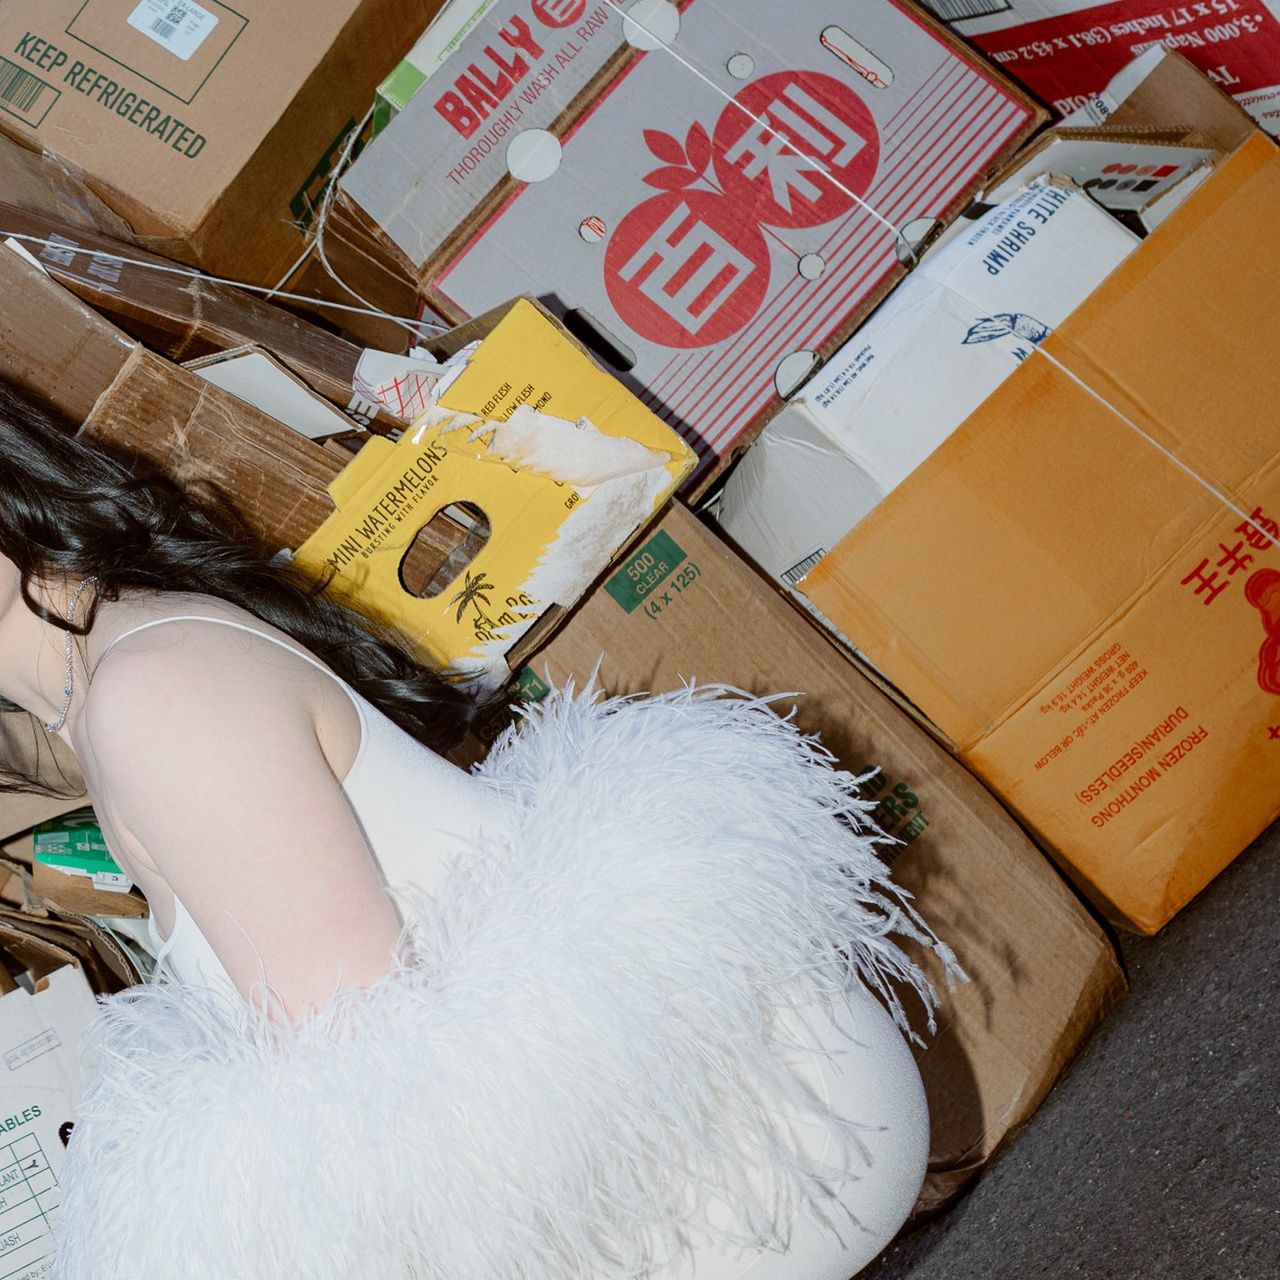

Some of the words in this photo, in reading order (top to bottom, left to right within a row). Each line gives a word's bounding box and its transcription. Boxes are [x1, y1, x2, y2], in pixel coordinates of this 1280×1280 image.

[1069, 27, 1111, 47] (38.1
[1111, 15, 1169, 34] Inches
[431, 14, 551, 138] BALLY
[15, 32, 67, 71] KEEP
[65, 62, 205, 158] REFRIGERATED
[447, 102, 523, 184] THOROUGHLY
[519, 64, 559, 104] WASH
[555, 42, 582, 69] ALL
[577, 6, 608, 41] RAW
[612, 74, 872, 342] 百利
[983, 222, 1035, 275] SHRIMP
[481, 401, 495, 416] RED
[493, 383, 512, 403] FLESH
[516, 384, 534, 407] FLESH
[326, 536, 362, 572] MINI
[356, 442, 446, 539] WATERMELONS
[361, 523, 395, 558] BURSTING
[395, 503, 413, 522] WITH
[412, 472, 438, 503] FLAVOR
[627, 553, 654, 580] 500
[636, 562, 668, 594] CLEAR
[644, 601, 661, 620] (4
[671, 562, 701, 592] 125)
[1094, 643, 1121, 670] GROSS
[1114, 651, 1130, 670] NET
[1067, 666, 1096, 694] WEIGHT
[1087, 666, 1116, 693] WEIGHT
[1129, 669, 1148, 689] KEEP
[1082, 692, 1104, 711] Packs
[1098, 687, 1129, 714] FROZEN
[1035, 745, 1062, 770] BELOW
[1077, 707, 1188, 801] DURIAN(SEEDLESS)
[1159, 726, 1208, 771] FROZEN
[1092, 768, 1161, 827] MONTHONG
